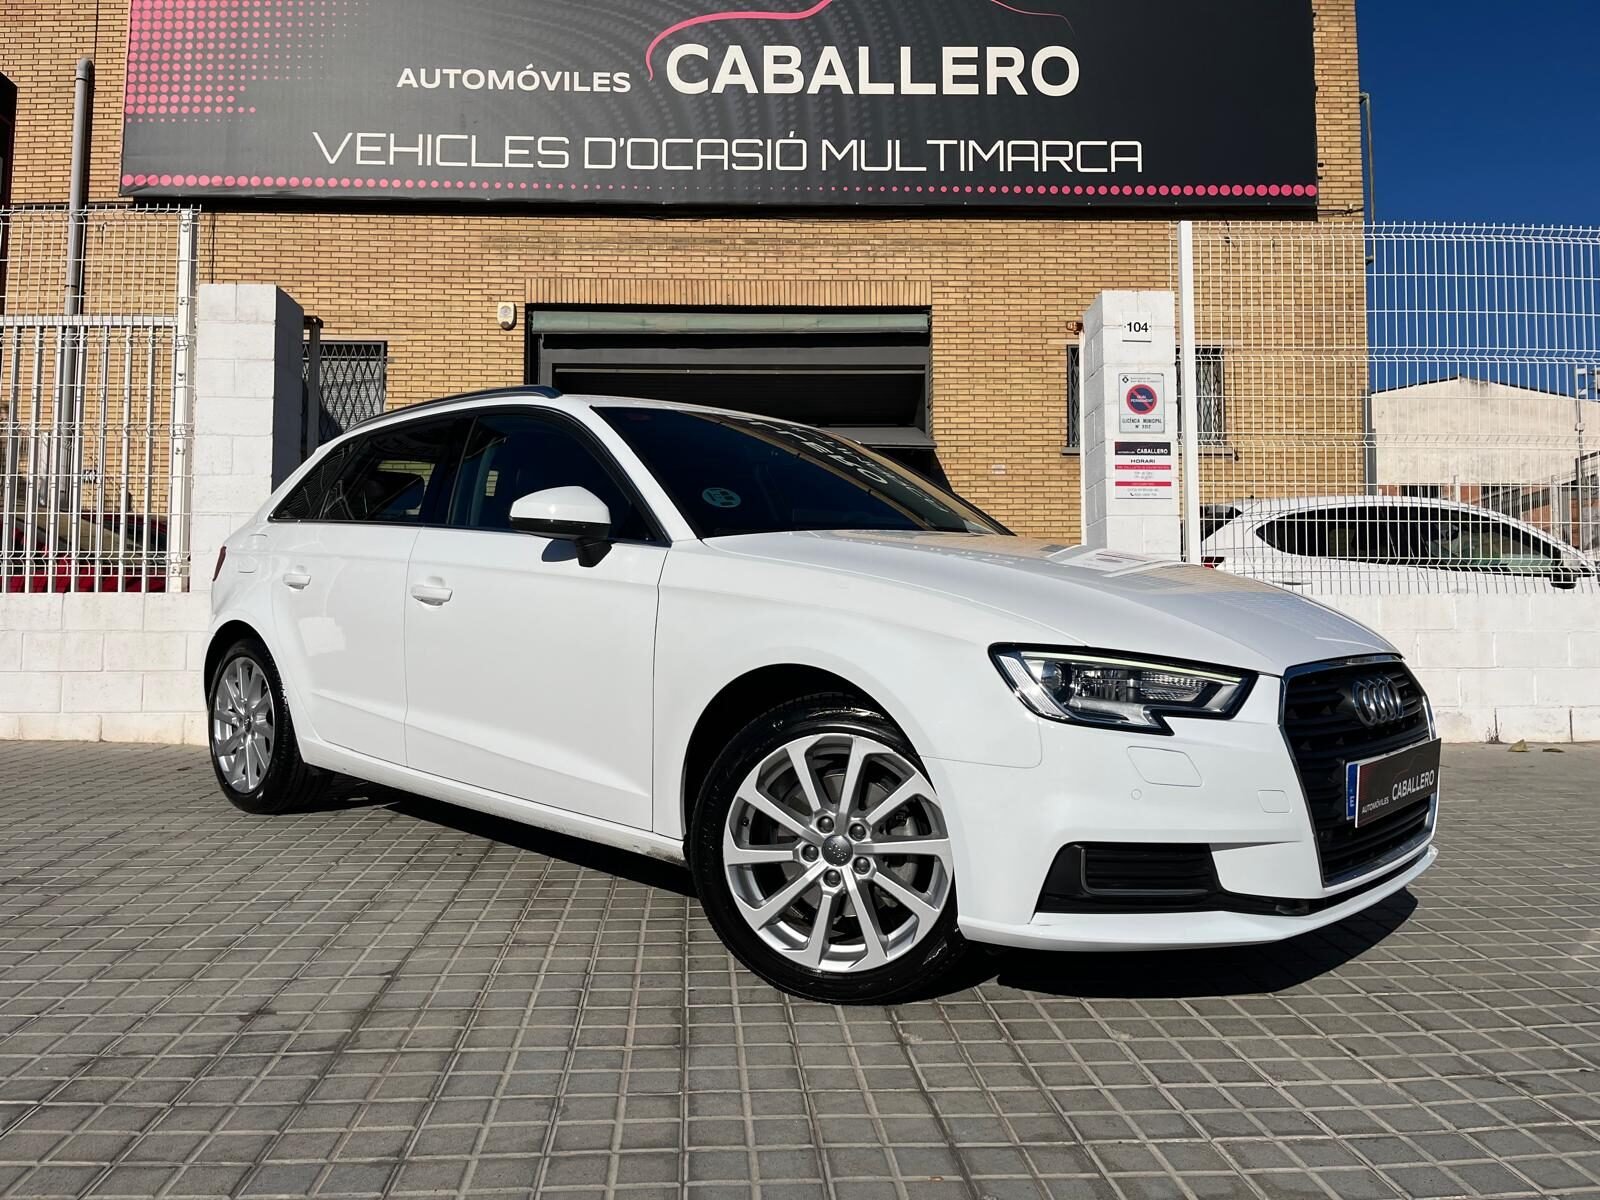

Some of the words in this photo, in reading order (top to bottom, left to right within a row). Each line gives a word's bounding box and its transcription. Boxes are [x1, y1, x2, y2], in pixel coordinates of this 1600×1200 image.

[396, 62, 632, 93] AUTOMÓVILES
[665, 43, 1081, 97] CABALLERO
[312, 131, 570, 169] VEHICLES
[583, 130, 808, 171] D'OCASIÓ
[821, 139, 1144, 173] MULTIMARCA
[1127, 321, 1149, 333] 104
[1350, 796, 1355, 807] E
[1362, 797, 1389, 813] AUTOMÓVILES
[1392, 770, 1435, 800] CABALLERO
